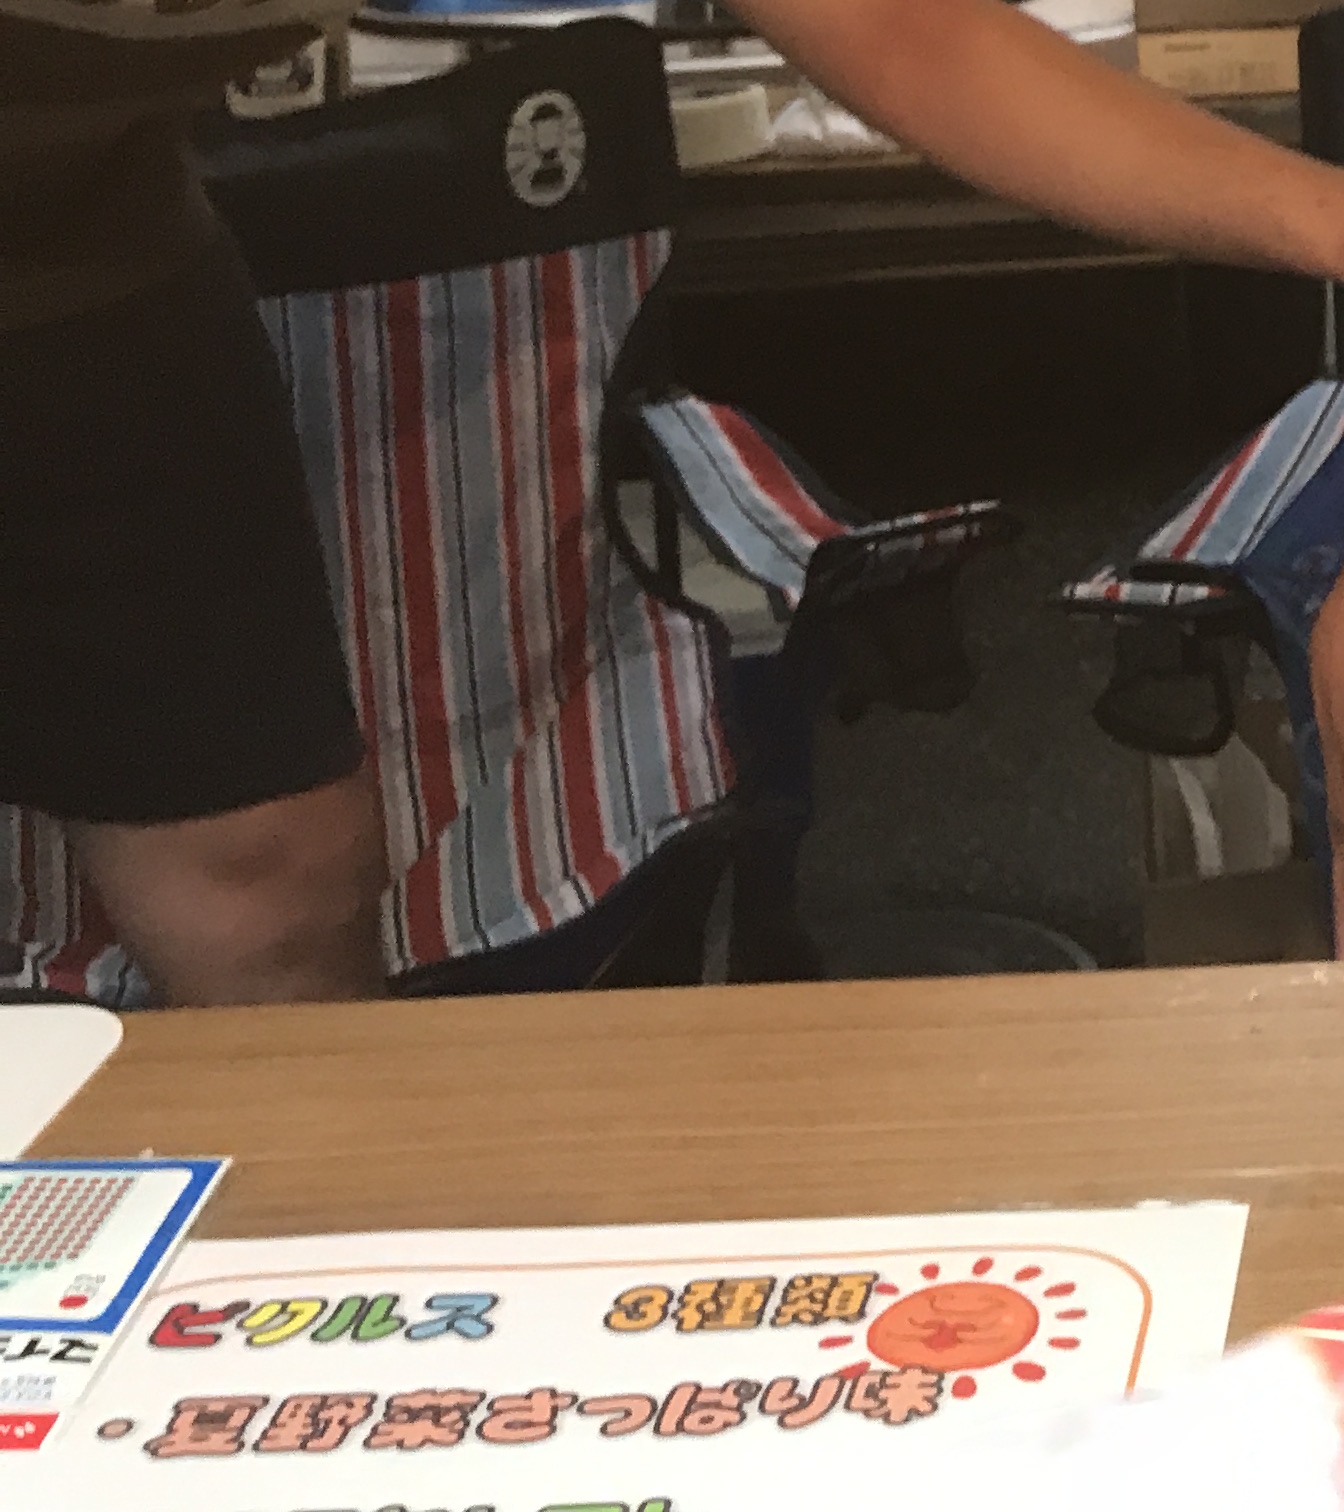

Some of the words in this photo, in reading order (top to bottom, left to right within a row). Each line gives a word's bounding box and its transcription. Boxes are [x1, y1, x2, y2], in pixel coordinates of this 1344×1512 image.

[149, 1292, 500, 1348] ピクルス
[603, 1271, 879, 1333] 3種類
